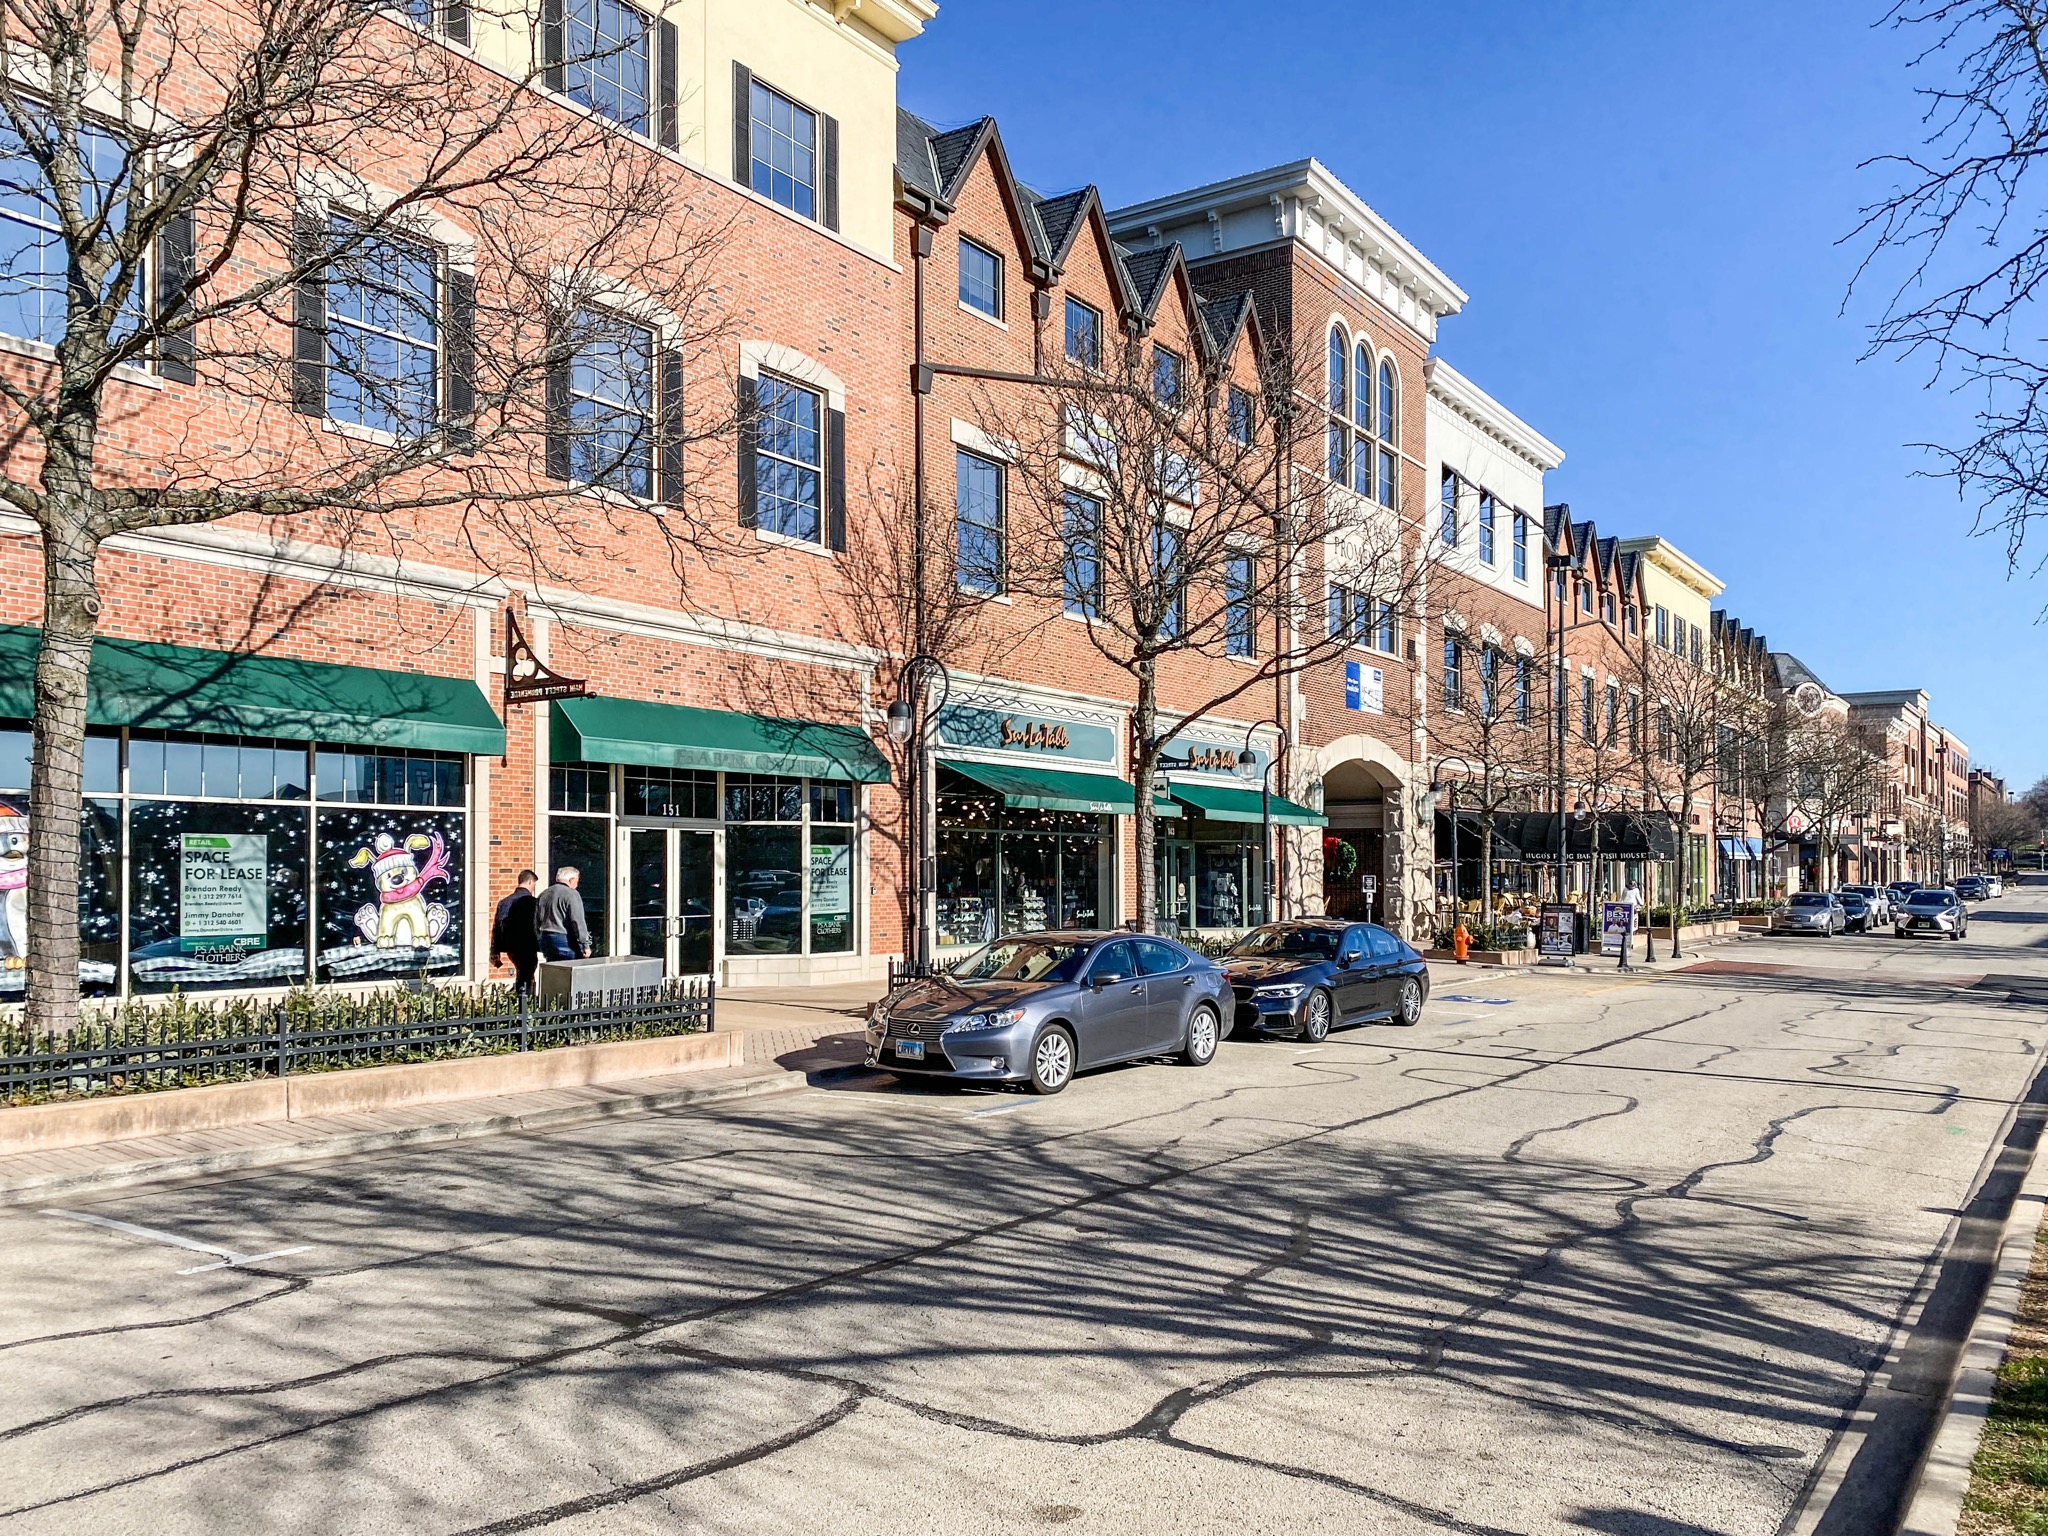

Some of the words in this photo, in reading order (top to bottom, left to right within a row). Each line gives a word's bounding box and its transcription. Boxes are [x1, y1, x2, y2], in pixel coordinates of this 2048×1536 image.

[662, 804, 680, 817] 151
[185, 851, 230, 864] SPACE
[1553, 852, 1574, 860] FG
[811, 857, 832, 865] SPACE
[185, 868, 215, 880] FOR
[220, 868, 263, 880] LEASE
[811, 868, 826, 877] FOR
[827, 867, 848, 876] LEASE
[219, 885, 242, 893] Reedy
[1606, 910, 1630, 919] BEST
[233, 937, 261, 946] CBRE
[218, 944, 246, 953] BANK
[194, 953, 247, 963] CLOTHIERS
